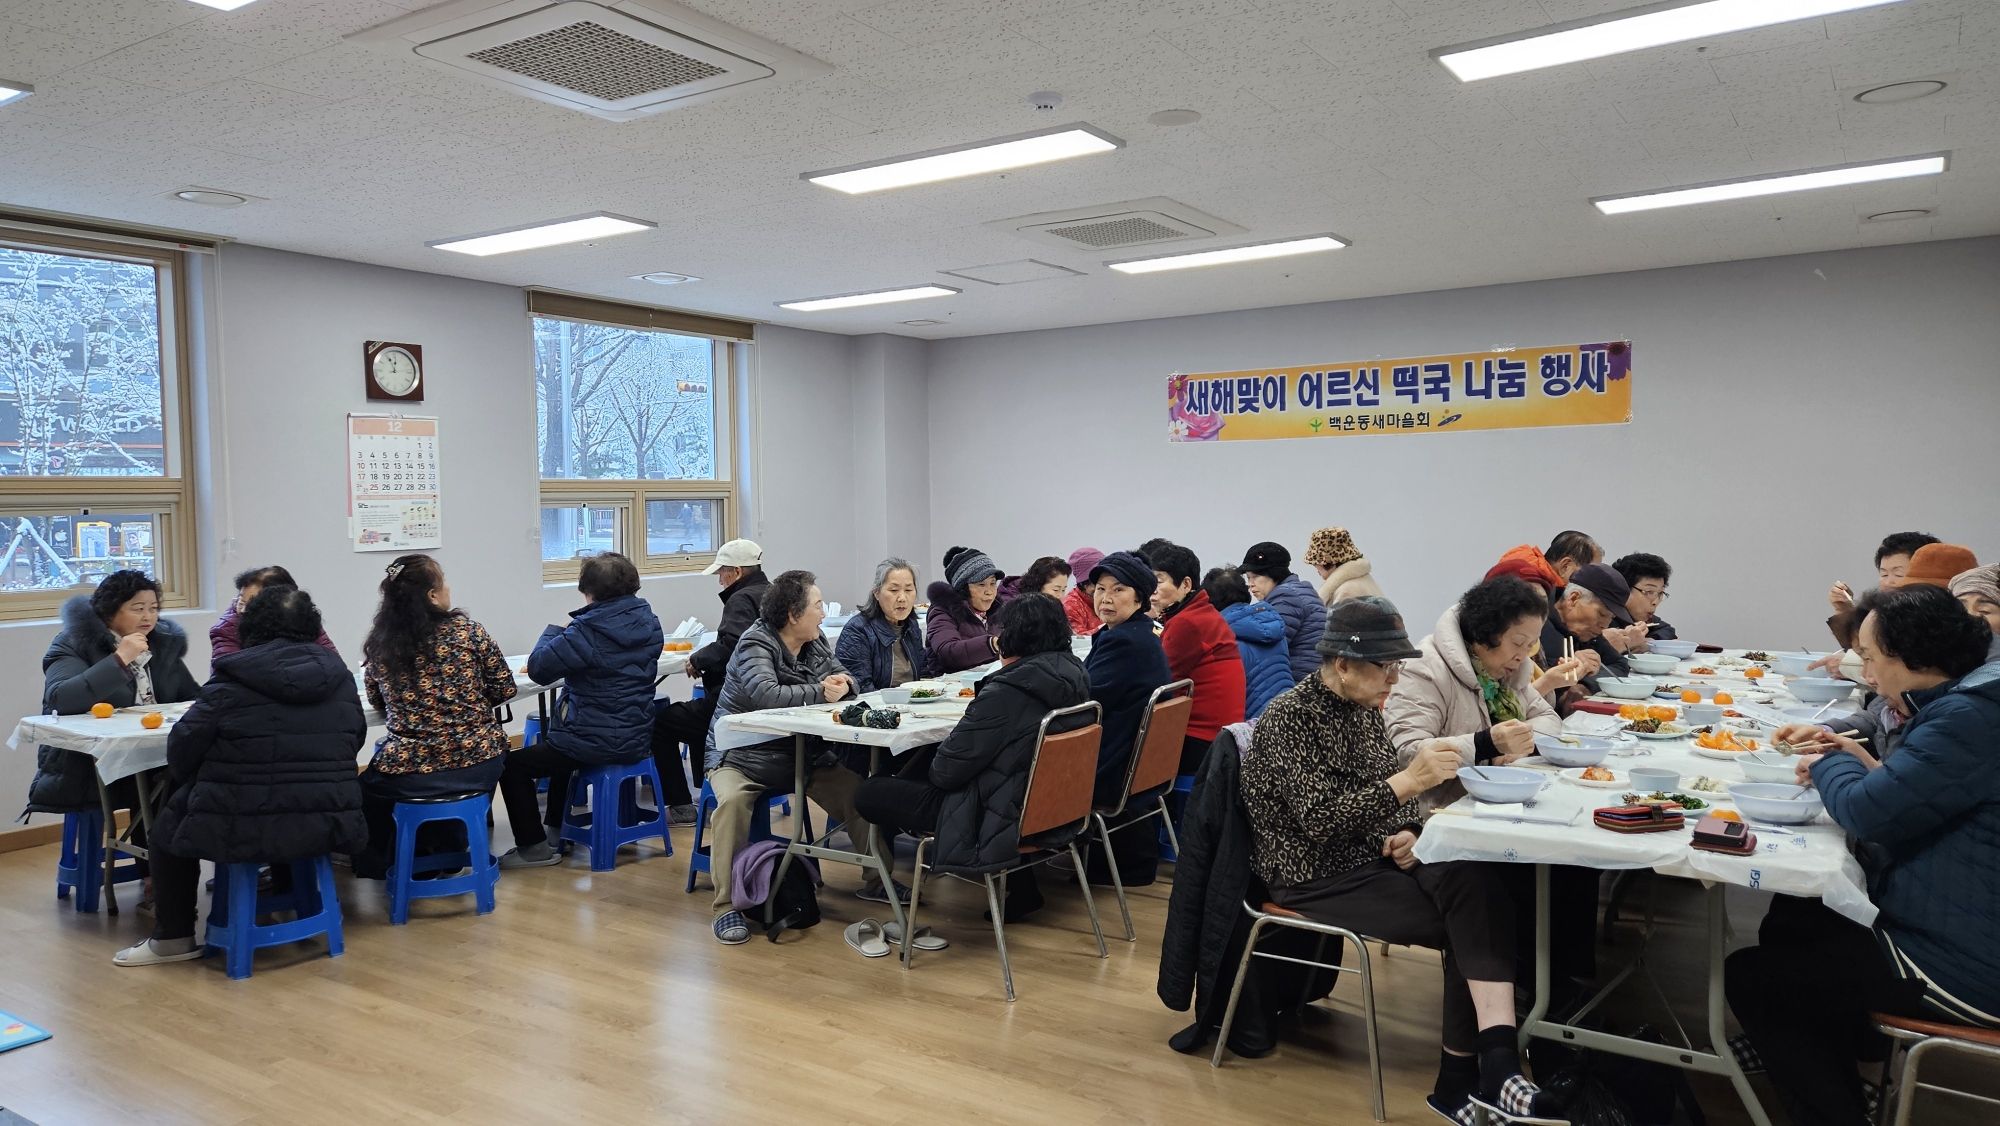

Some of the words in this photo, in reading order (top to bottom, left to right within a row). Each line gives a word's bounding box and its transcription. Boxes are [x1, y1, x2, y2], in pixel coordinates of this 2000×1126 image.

[1185, 375, 1287, 415] 새해맞이
[1297, 368, 1380, 410] 어르신
[1392, 363, 1452, 405] 떡국
[1464, 358, 1527, 400] 나눔
[1540, 351, 1609, 397] 행사
[387, 421, 403, 432] 12
[1328, 411, 1430, 431] 백운동새마을회
[369, 483, 379, 491] 25
[381, 483, 391, 491] 26
[394, 483, 403, 491] 27
[406, 483, 415, 491] 28
[417, 483, 426, 491] 29
[428, 483, 437, 491] 30
